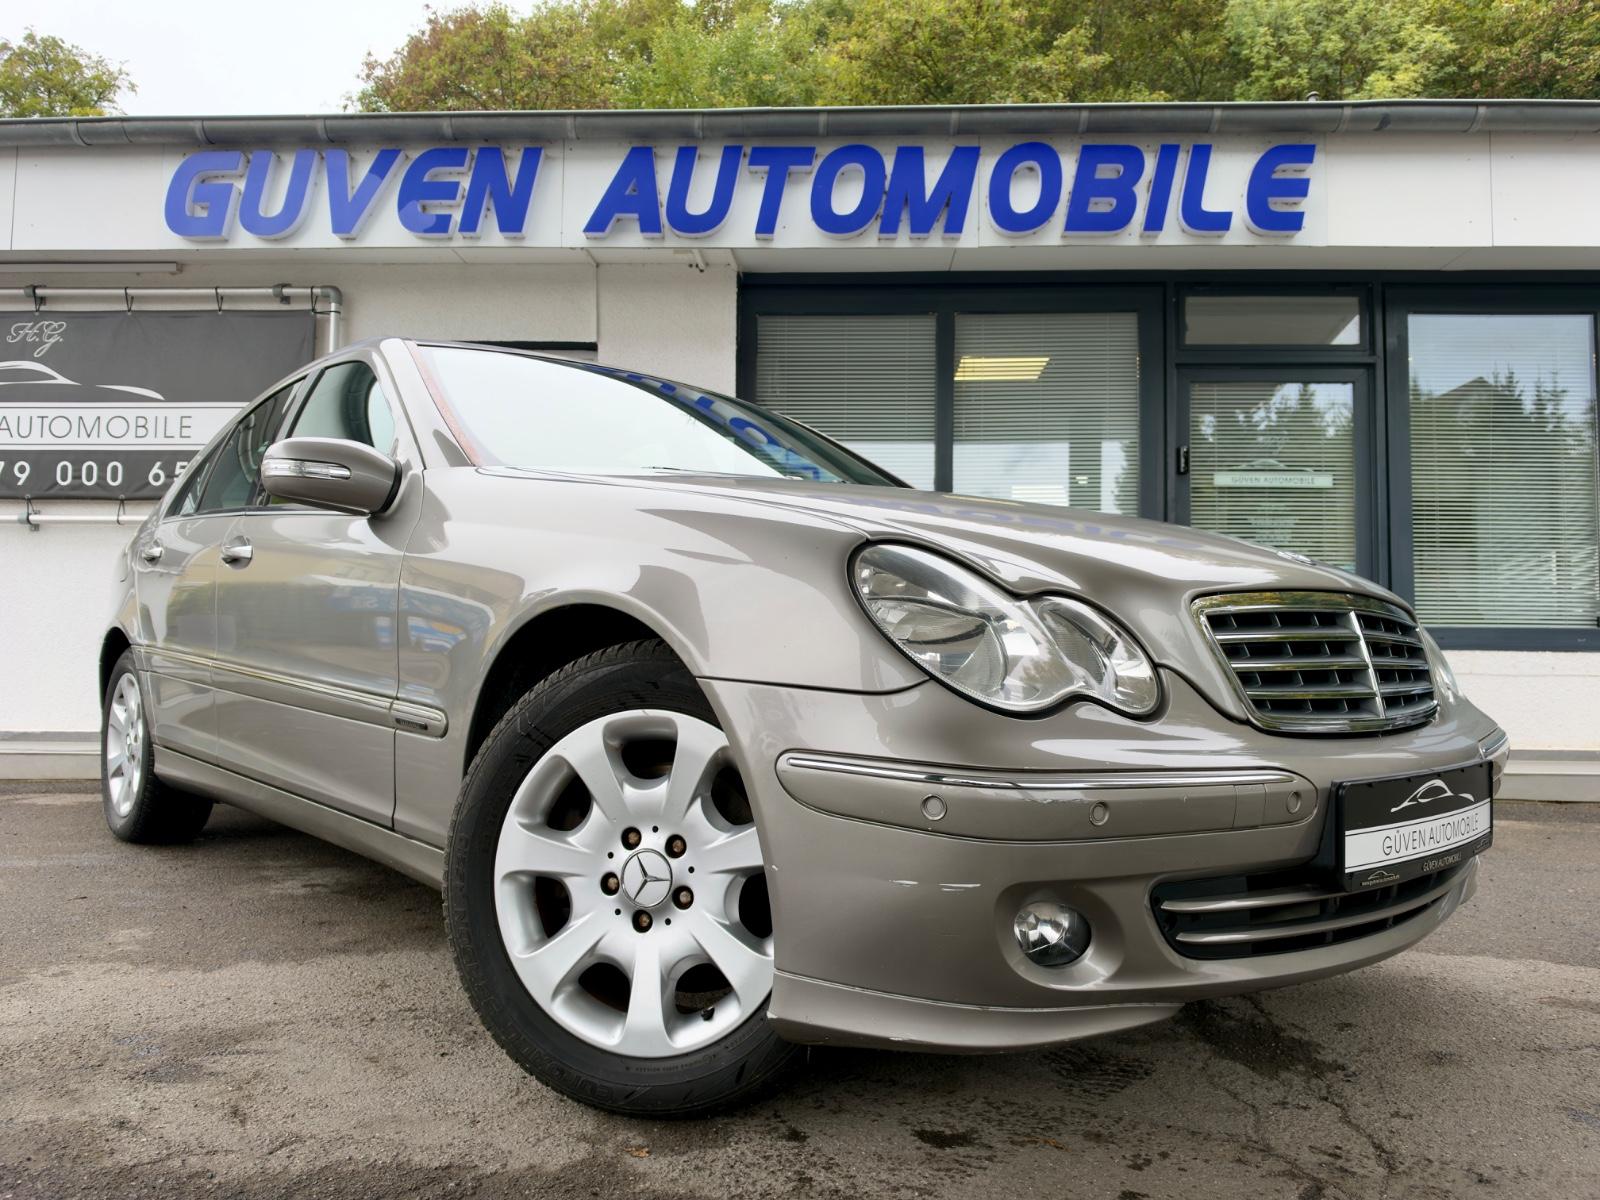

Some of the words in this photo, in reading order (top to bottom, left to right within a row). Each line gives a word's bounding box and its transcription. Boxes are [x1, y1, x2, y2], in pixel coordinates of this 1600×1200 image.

[163, 145, 545, 240] GUVEN
[583, 141, 1317, 240] AUTOMOBILE
[0, 415, 192, 438] AUTOMOBILE
[56, 460, 123, 486] 000
[1382, 829, 1426, 856] GÜVEN
[1428, 813, 1479, 846] AUTOMOBILE
